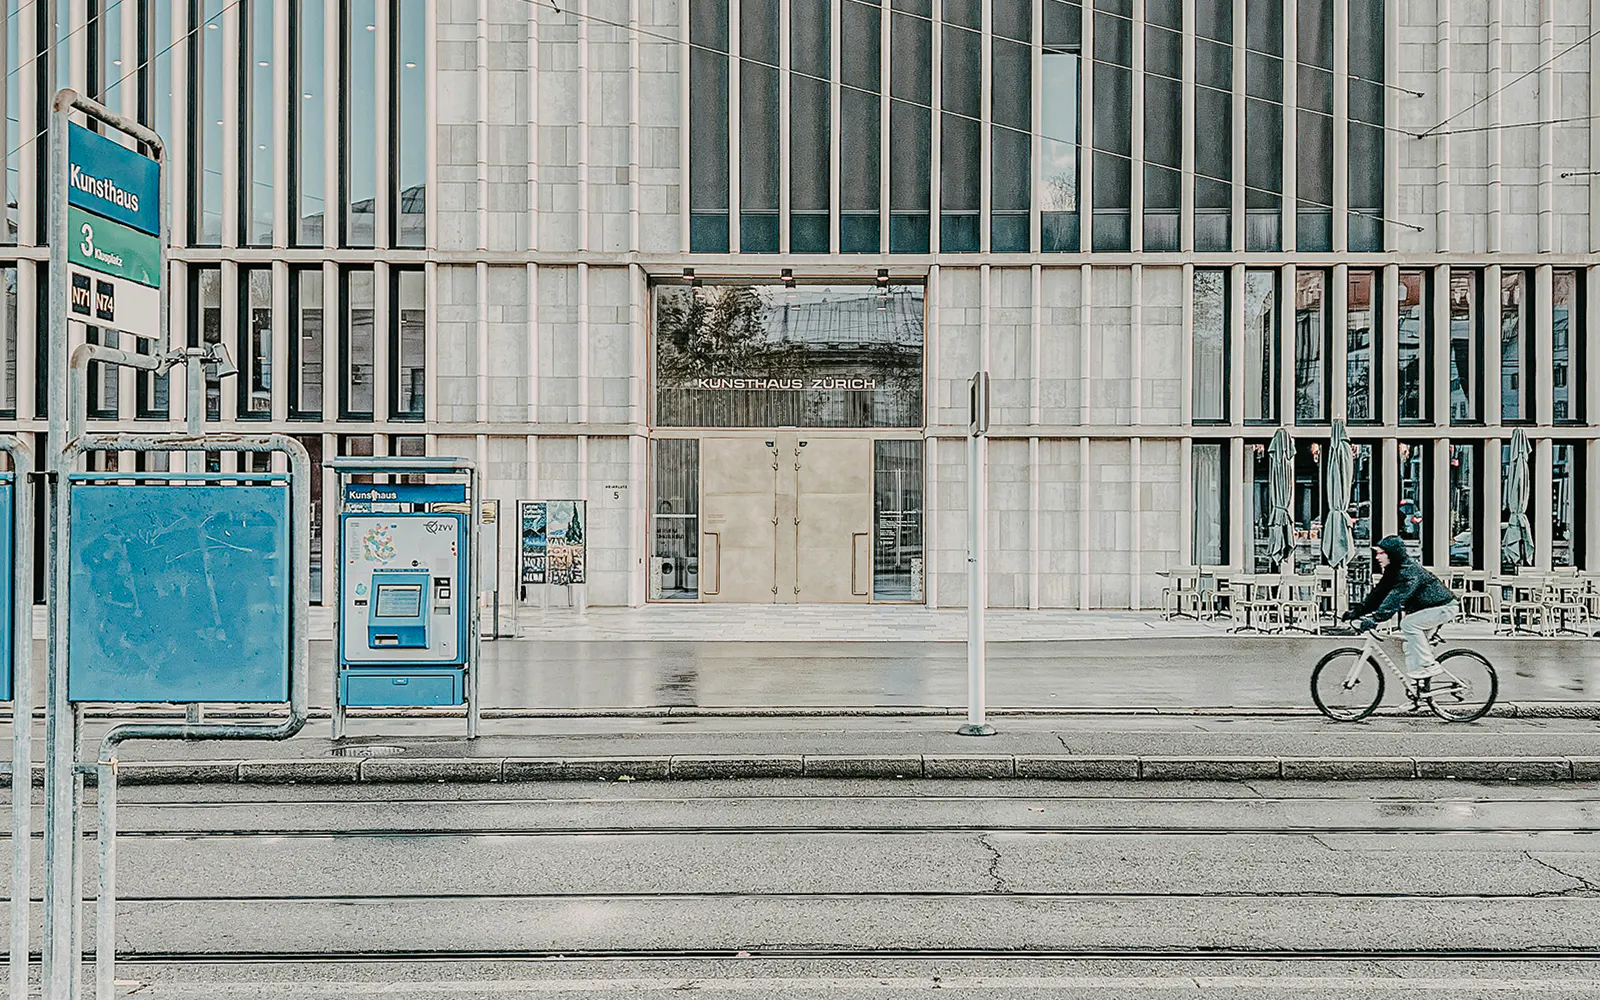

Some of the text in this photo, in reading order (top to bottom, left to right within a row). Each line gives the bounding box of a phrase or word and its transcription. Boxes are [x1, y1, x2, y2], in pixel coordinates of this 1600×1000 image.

[69, 162, 139, 212] Kunsthaus
[80, 223, 94, 257] 3
[72, 285, 90, 307] N71
[96, 293, 114, 313] N74
[698, 376, 876, 389] KUNSTHAUS ZÜRICH
[613, 491, 620, 500] 5
